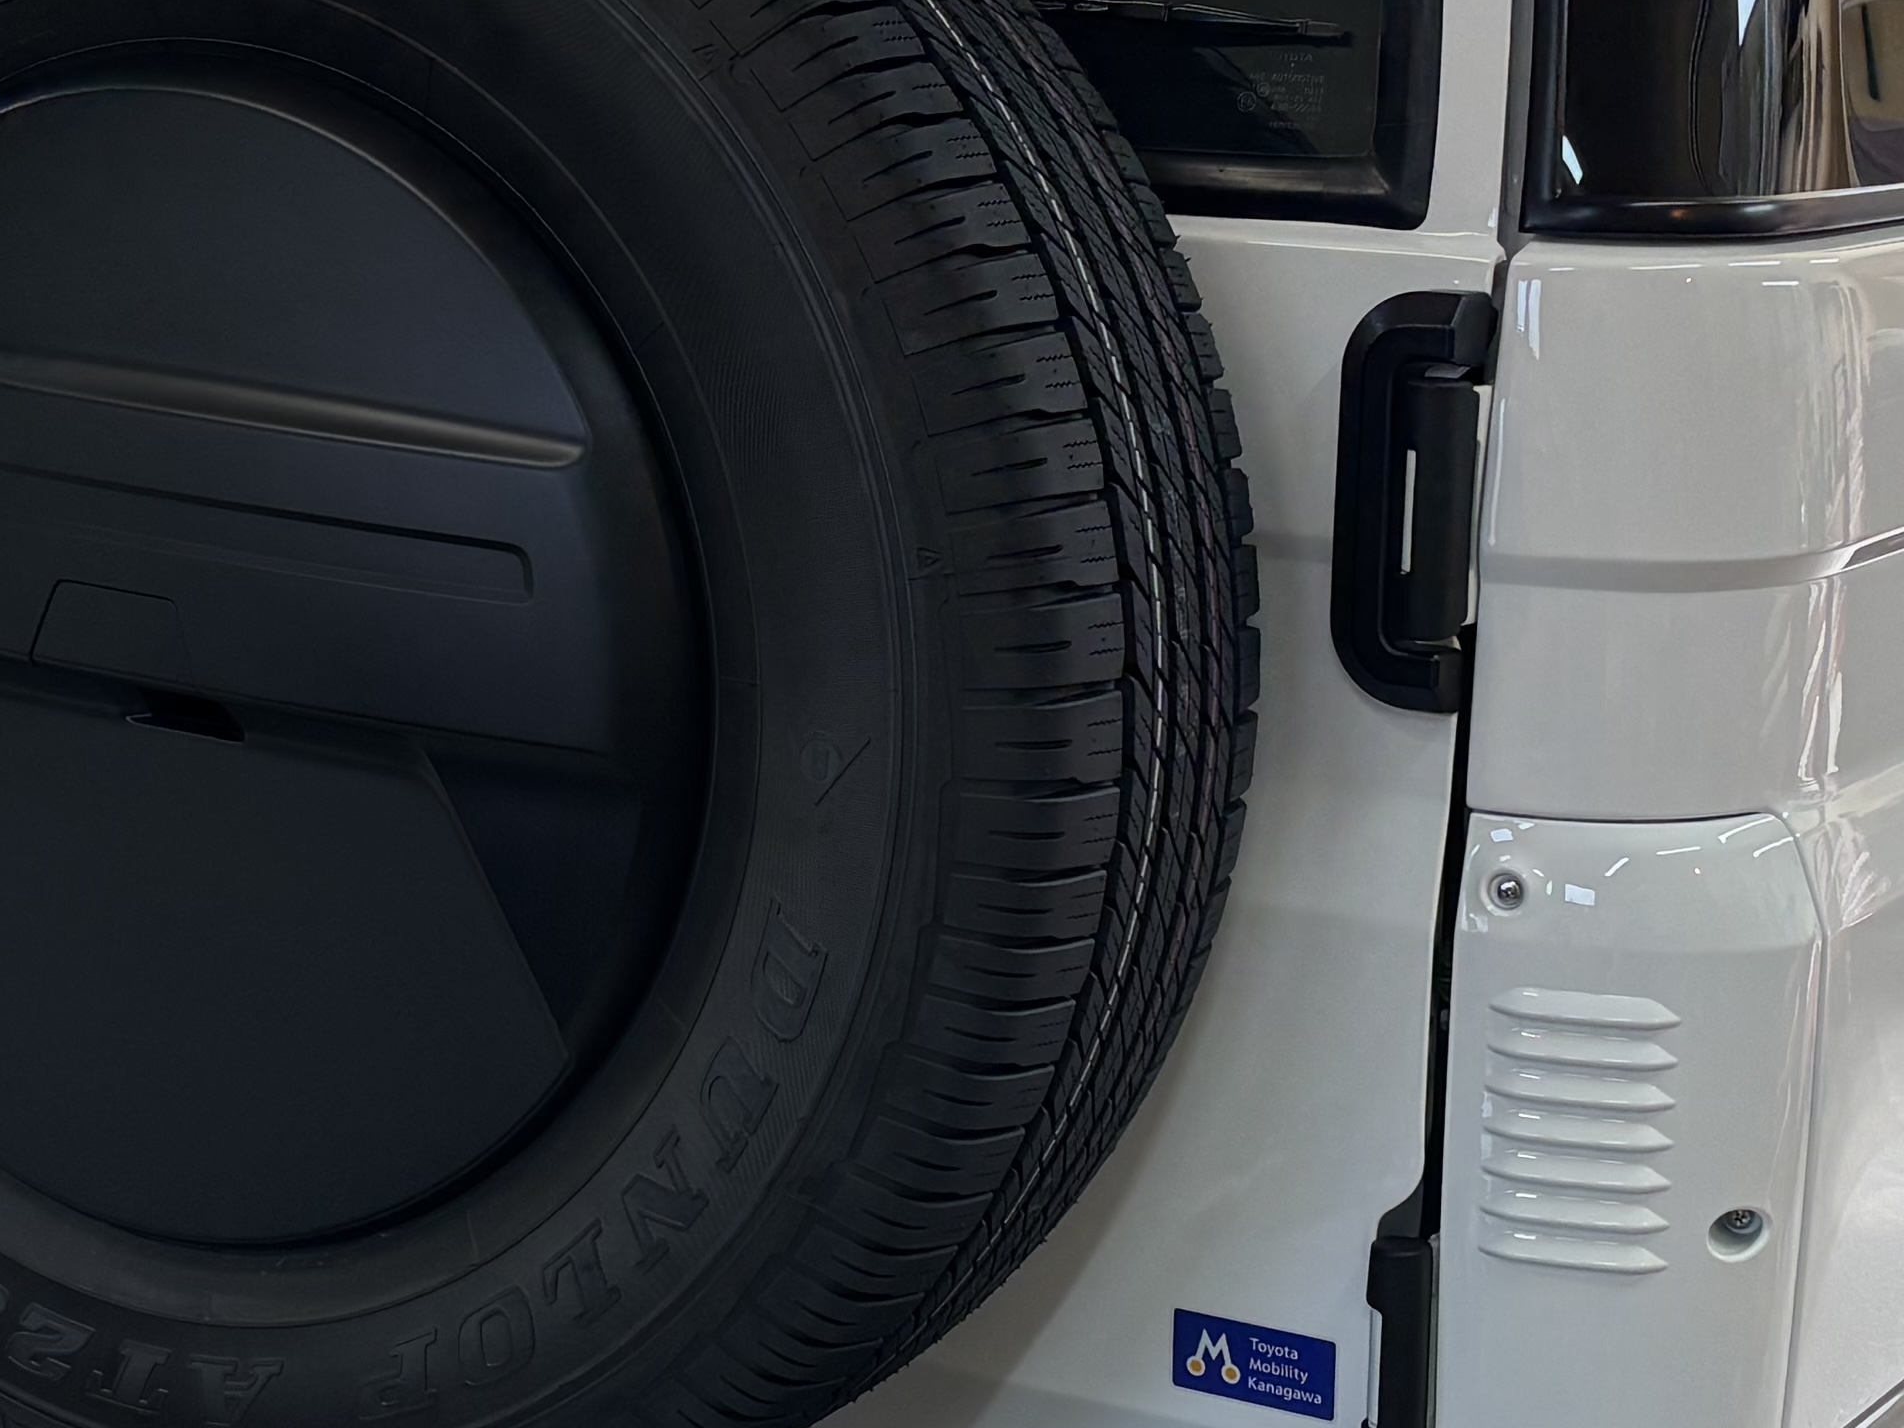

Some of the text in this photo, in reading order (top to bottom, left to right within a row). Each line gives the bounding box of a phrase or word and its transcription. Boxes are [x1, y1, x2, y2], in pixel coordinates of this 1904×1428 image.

[1249, 1338, 1299, 1361] Toyota
[1249, 1357, 1309, 1384] Mobility
[1248, 1376, 1322, 1404] Kanagawa
